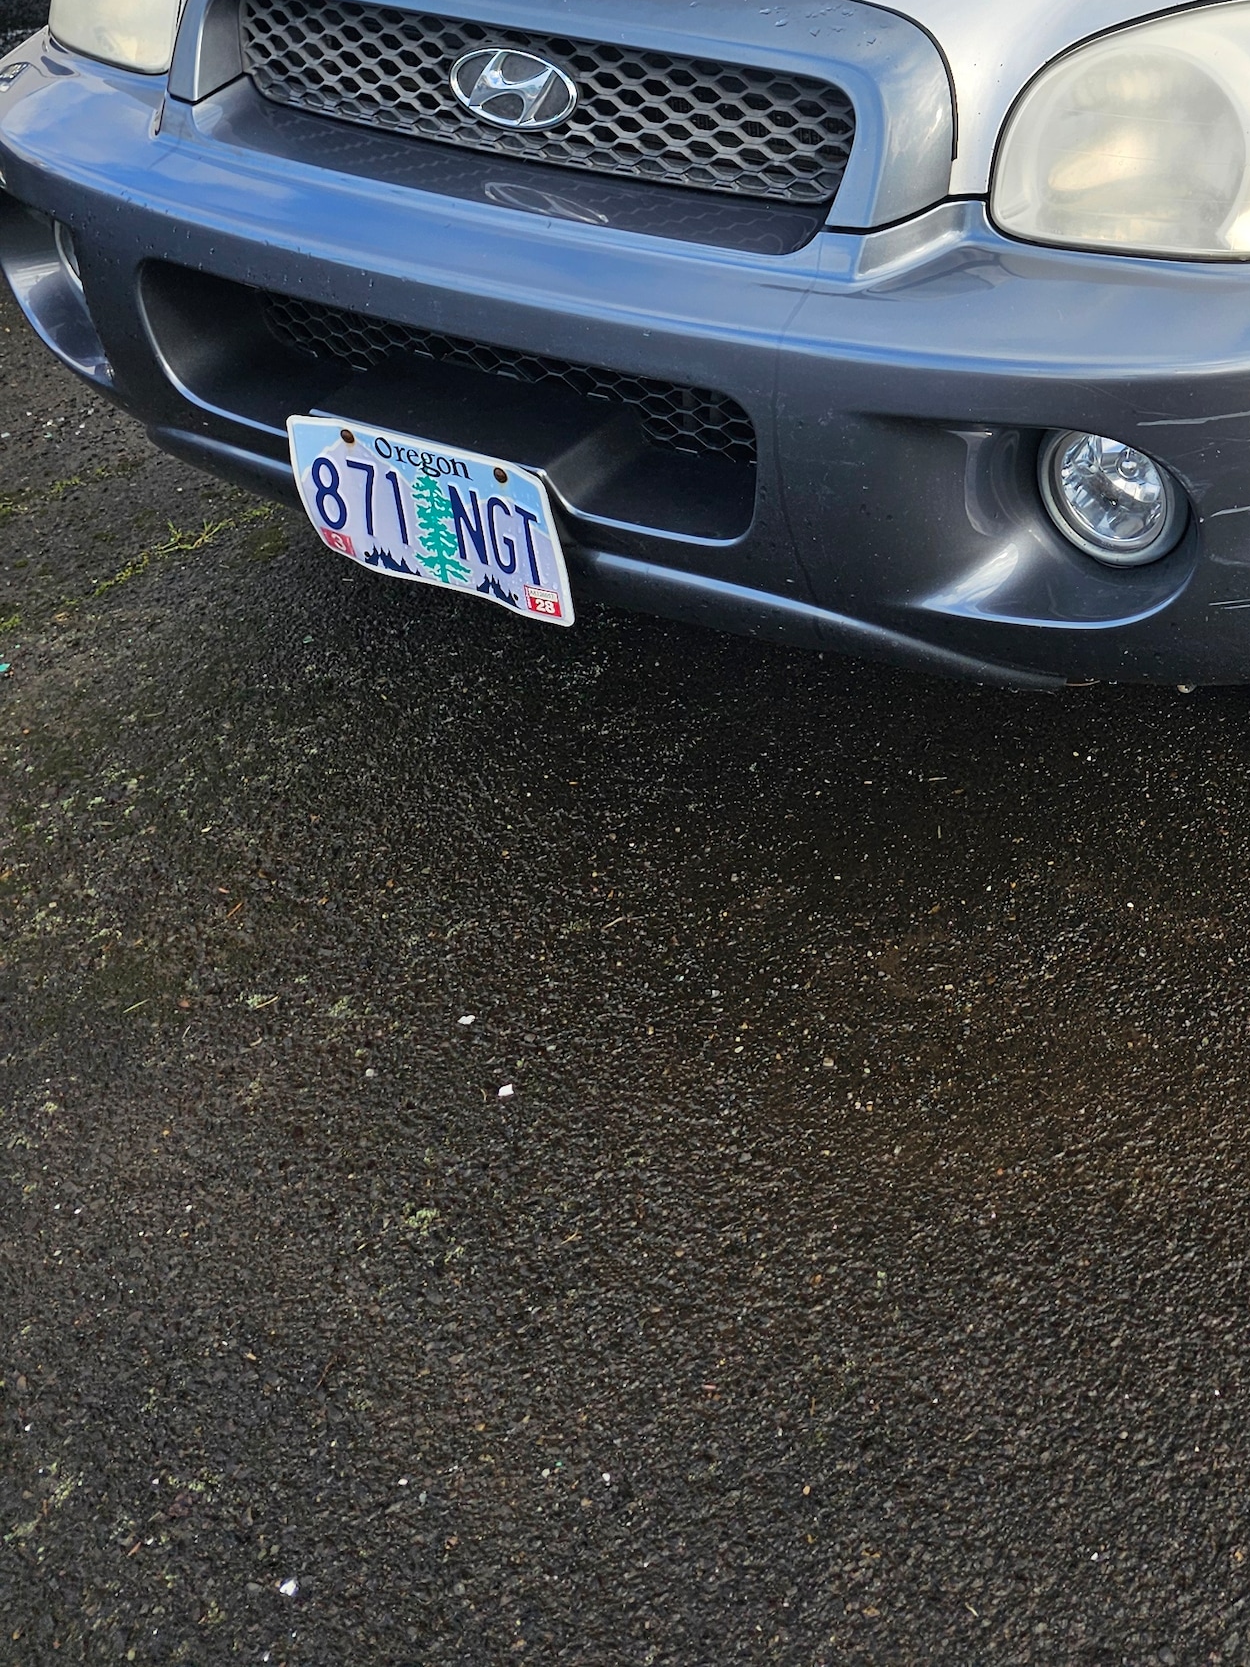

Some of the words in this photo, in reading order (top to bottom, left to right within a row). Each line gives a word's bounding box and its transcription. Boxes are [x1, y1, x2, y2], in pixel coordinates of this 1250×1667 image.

[374, 436, 474, 481] Oregon
[311, 456, 410, 546] 871
[448, 484, 541, 586] NGT
[330, 532, 347, 552] 3
[535, 598, 555, 615] 28
